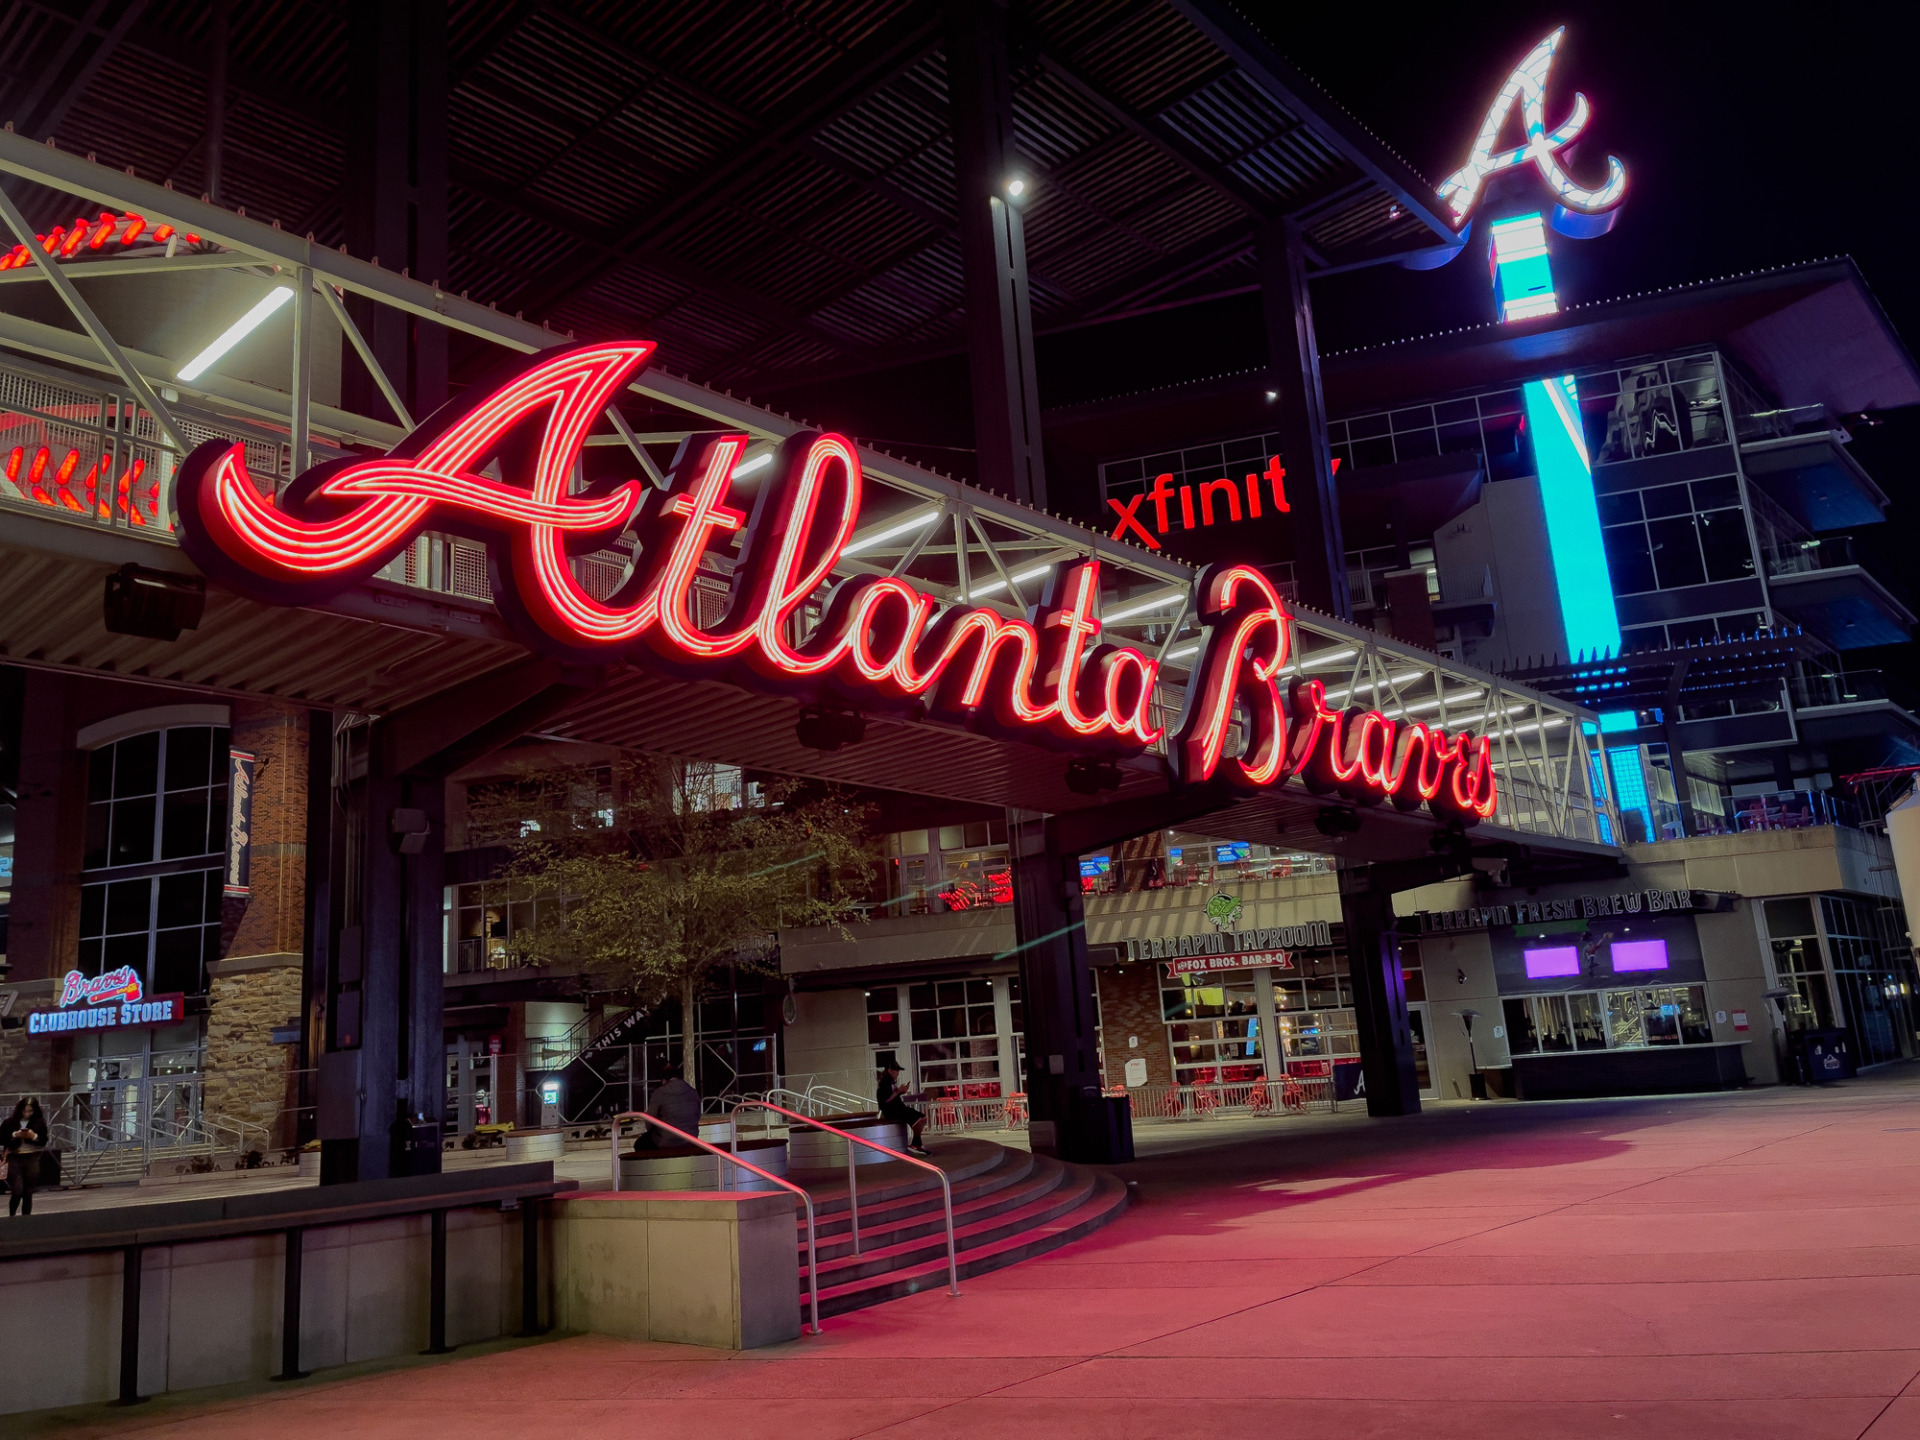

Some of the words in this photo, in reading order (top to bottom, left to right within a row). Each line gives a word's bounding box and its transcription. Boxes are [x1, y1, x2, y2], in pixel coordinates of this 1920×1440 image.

[1437, 25, 1626, 226] A
[1106, 454, 1342, 550] xfinit
[200, 340, 1164, 745] Atlanta
[1198, 563, 1499, 819] Braves
[1415, 906, 1512, 933] TERRAPIN
[1515, 899, 1578, 924] FRESH
[1581, 892, 1642, 919] BREW
[1646, 888, 1694, 912] BAR
[1121, 932, 1226, 962] TERRAPIN
[1229, 920, 1333, 951] TAPROOM
[1187, 959, 1207, 970] FOX
[1209, 957, 1239, 968] BROS.
[1241, 952, 1284, 966] BAR-B-Q
[60, 965, 130, 1008] Braves
[29, 1007, 117, 1034] CLUBHOUSE
[121, 1000, 173, 1025] STORE
[595, 1027, 622, 1051] THIS
[623, 1004, 650, 1028] WAY
